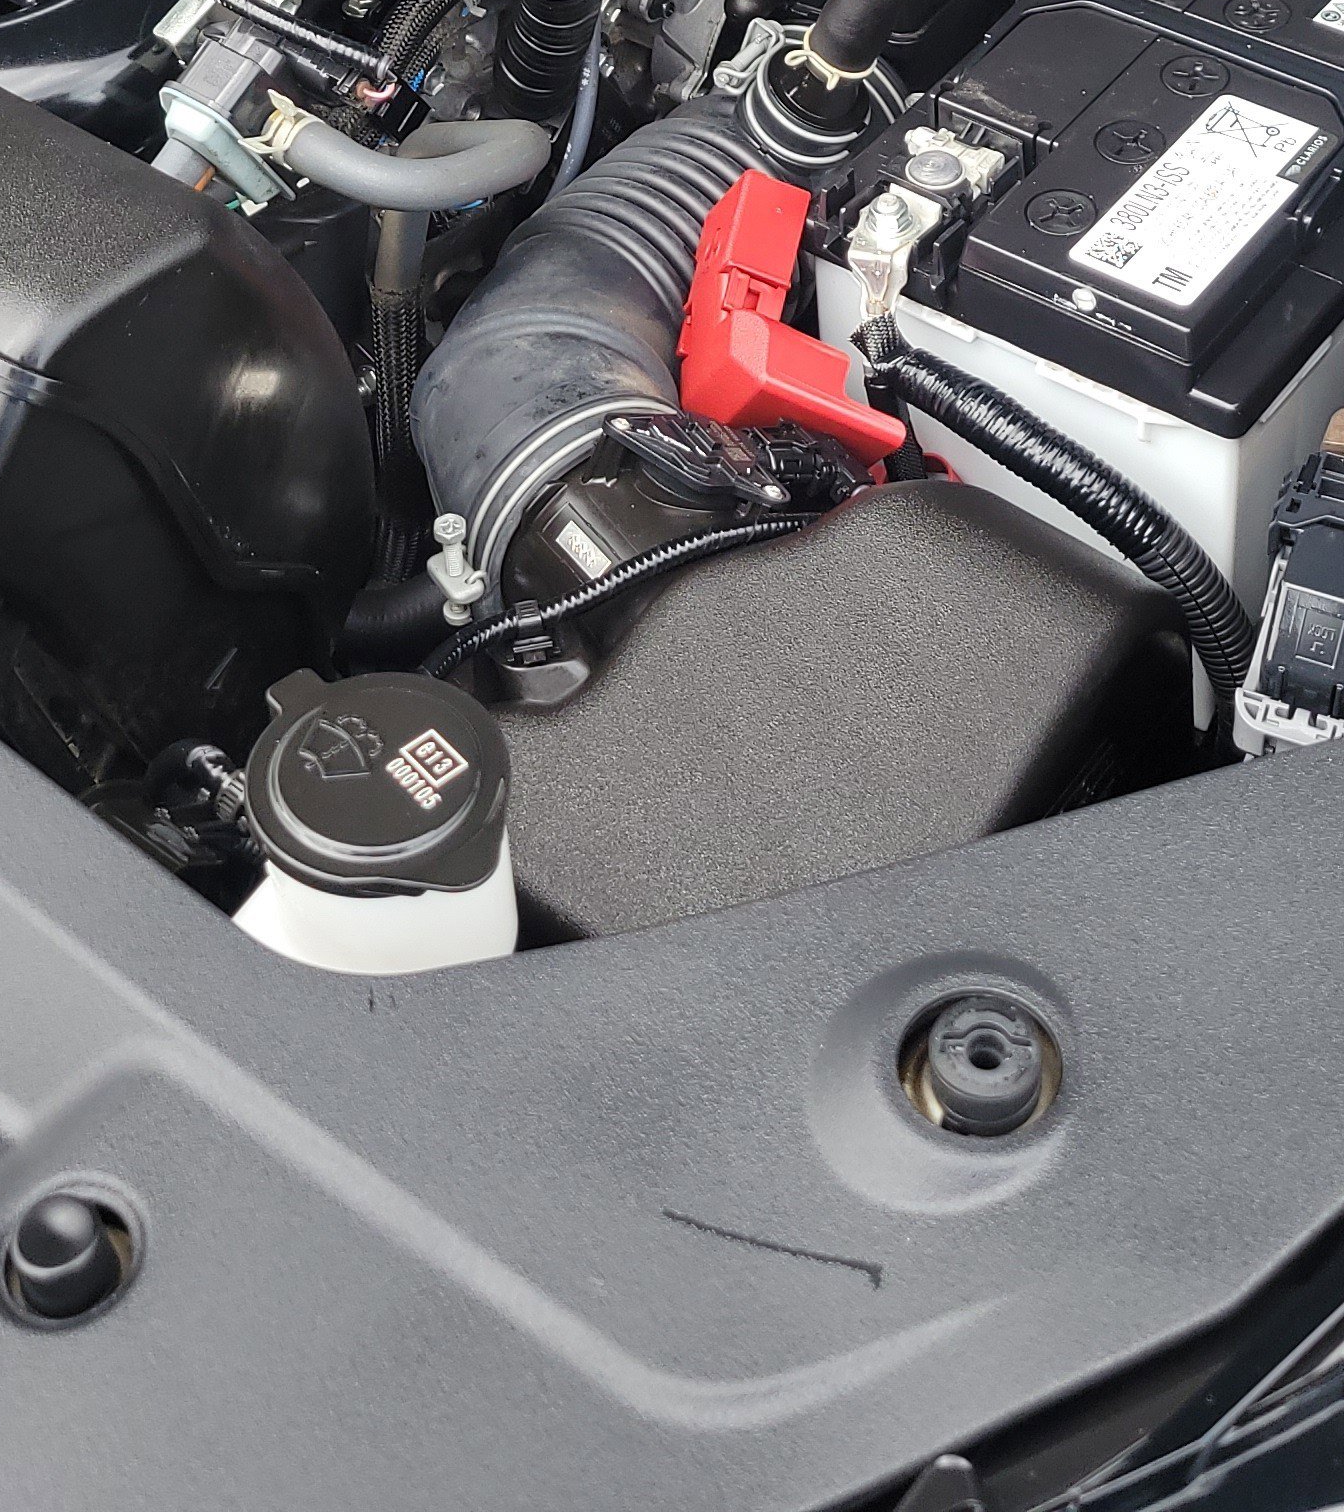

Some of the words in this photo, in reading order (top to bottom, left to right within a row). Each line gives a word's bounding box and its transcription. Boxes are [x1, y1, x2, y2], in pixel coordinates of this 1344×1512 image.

[1296, 134, 1329, 166] CLARIOS
[1109, 162, 1191, 232] 380LN3-ISS
[1152, 266, 1193, 292] TM
[415, 740, 454, 775] e13
[384, 756, 444, 811] 000105
